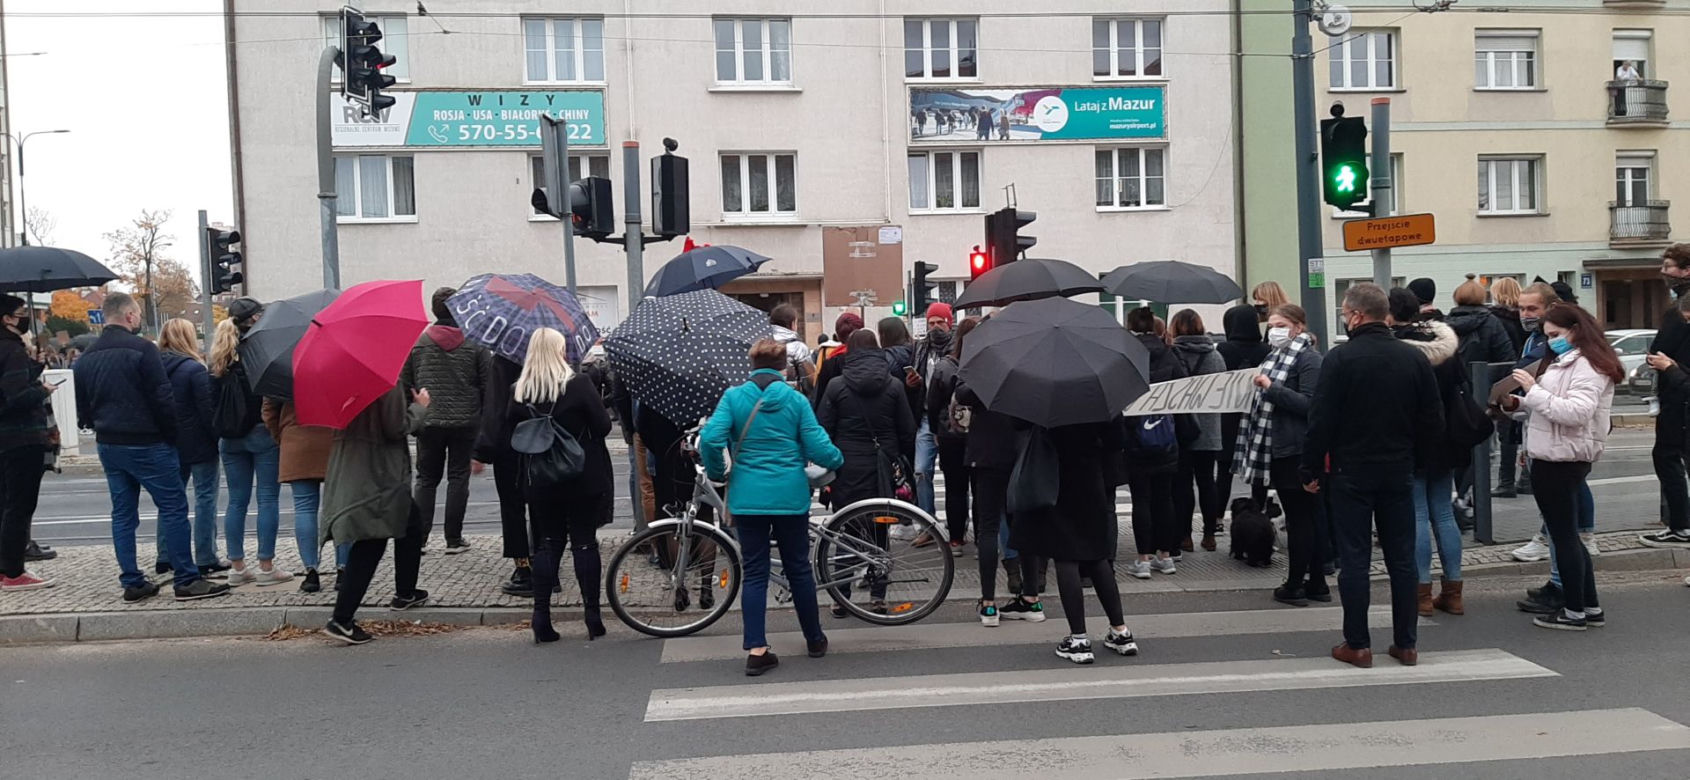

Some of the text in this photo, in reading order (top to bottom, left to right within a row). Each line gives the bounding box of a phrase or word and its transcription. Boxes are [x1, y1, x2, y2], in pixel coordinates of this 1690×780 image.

[468, 95, 555, 106] WIZY
[1074, 97, 1155, 114] Lataj z Mazur
[433, 109, 465, 121] ROSJA
[473, 109, 493, 121] USA
[558, 109, 589, 121] CHINY
[458, 124, 592, 140] 570-55-22
[1357, 232, 1423, 246] dwuetapowe
